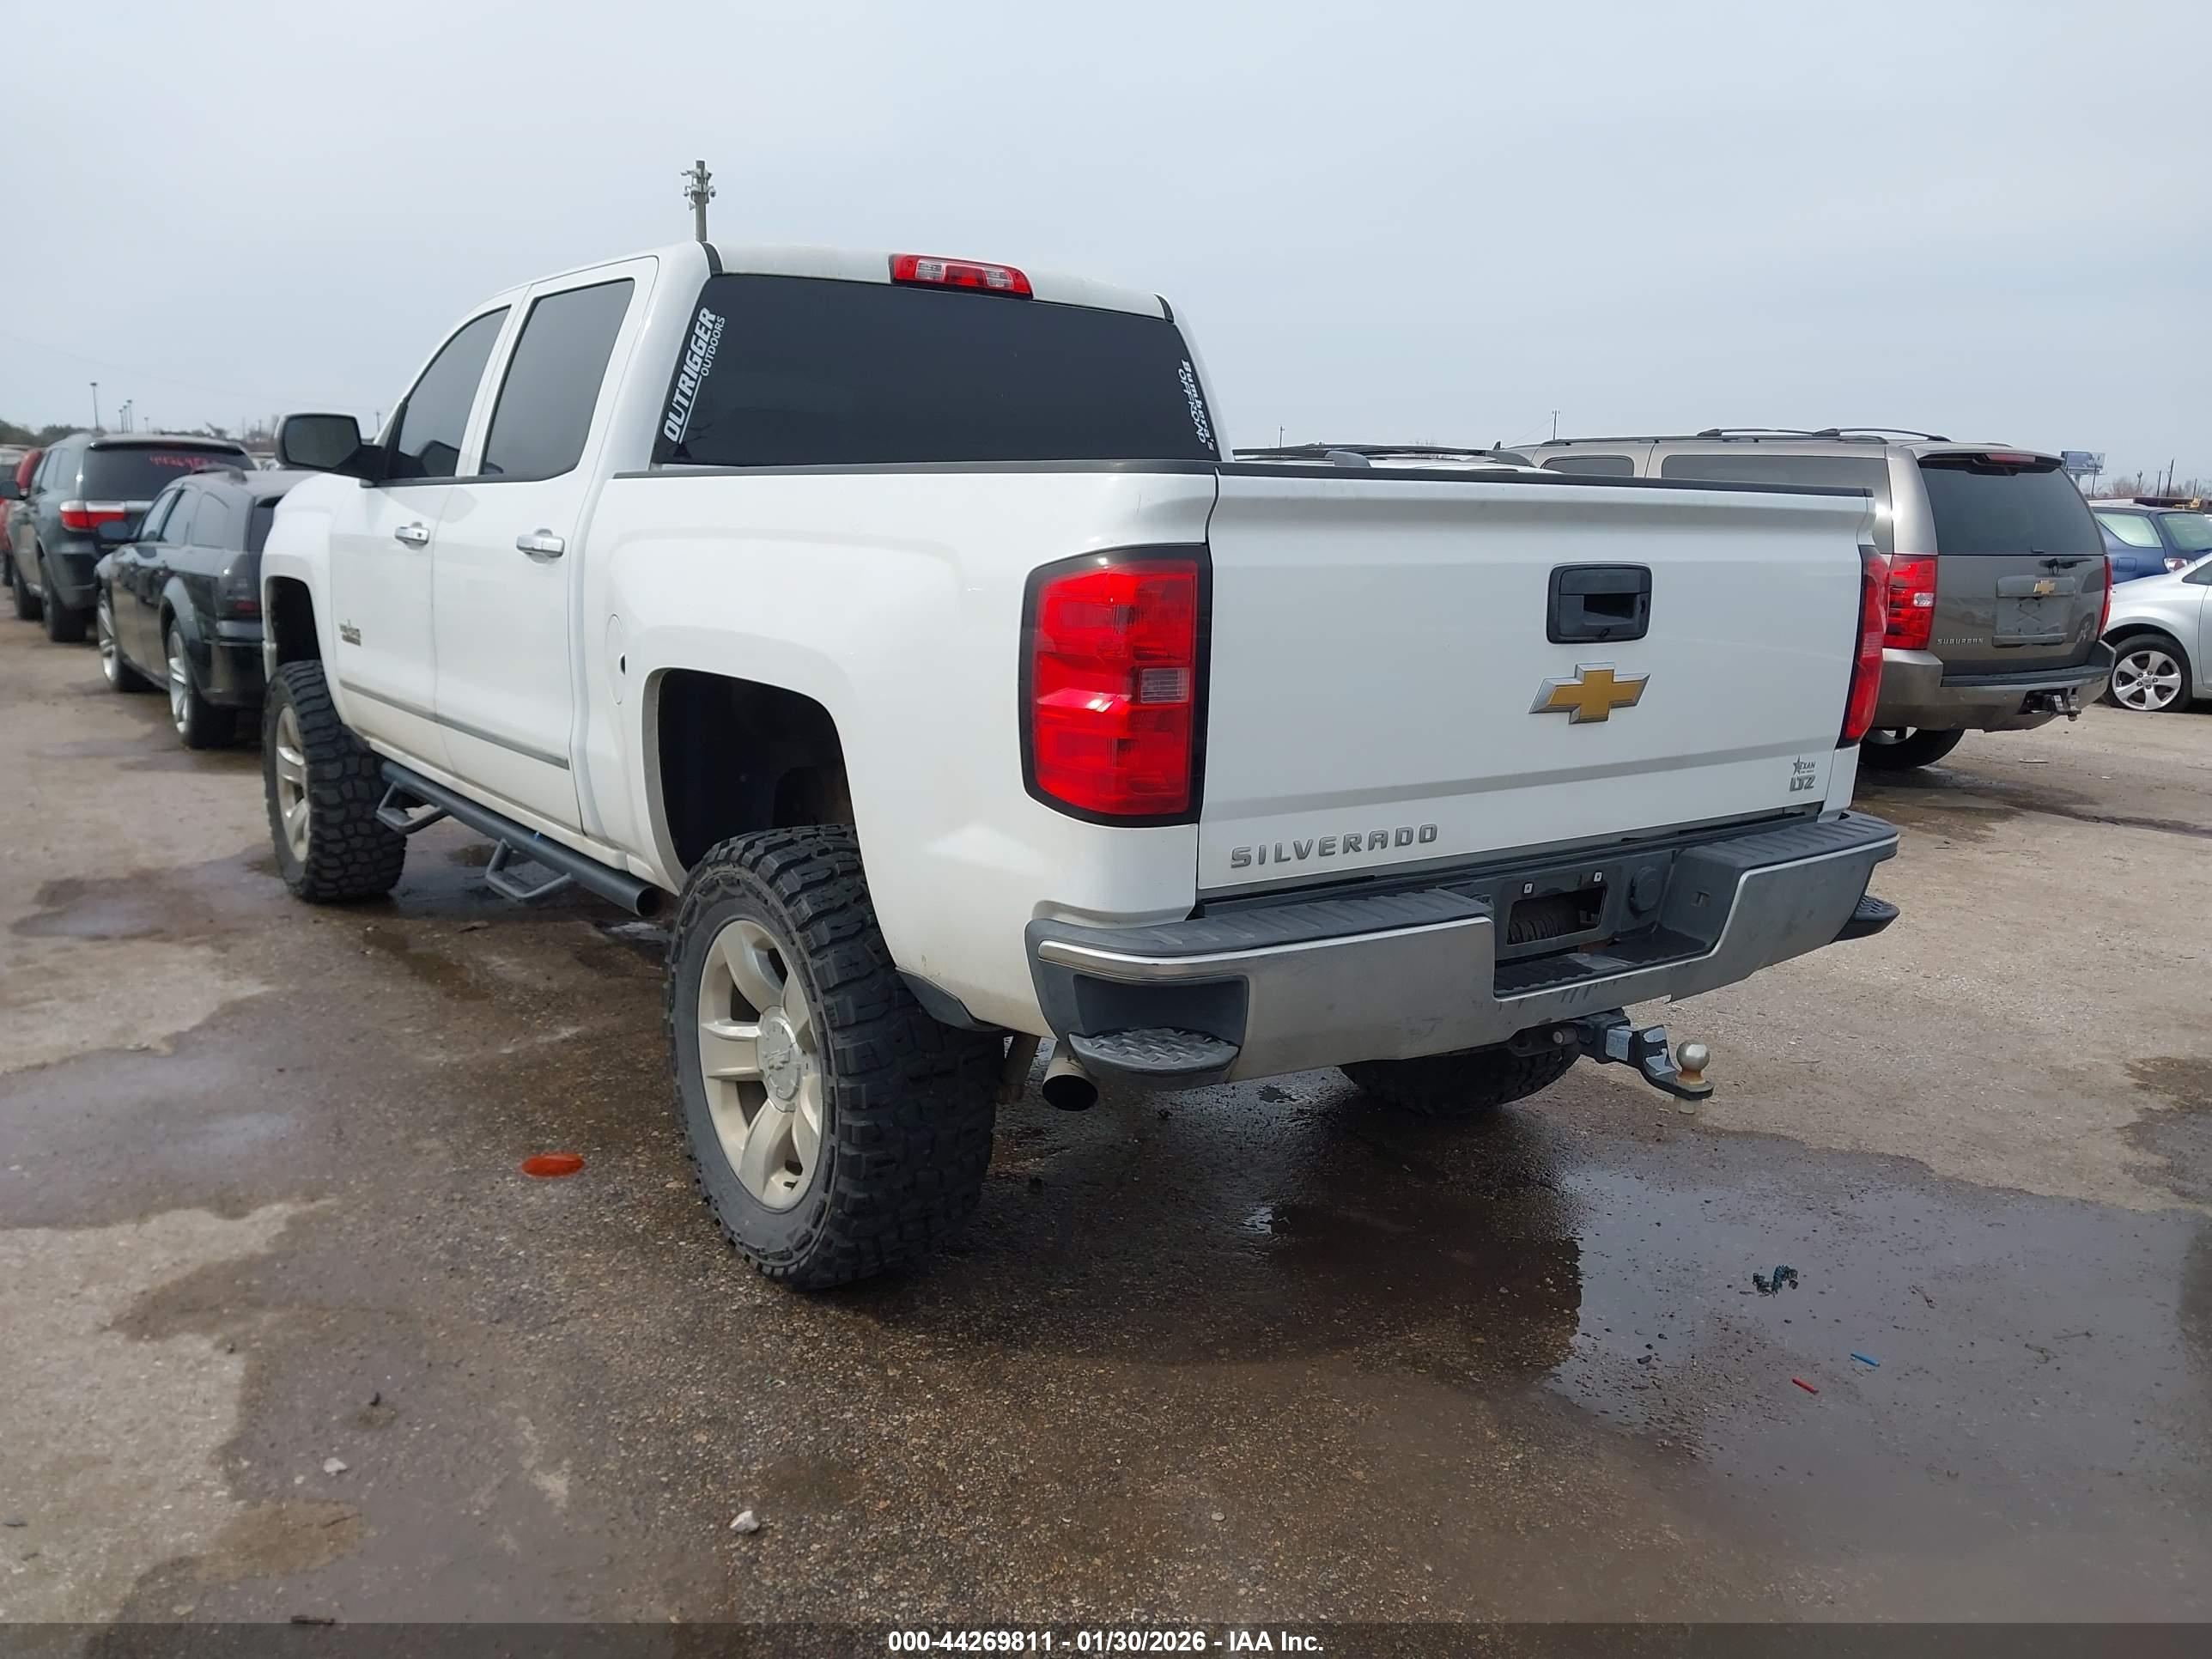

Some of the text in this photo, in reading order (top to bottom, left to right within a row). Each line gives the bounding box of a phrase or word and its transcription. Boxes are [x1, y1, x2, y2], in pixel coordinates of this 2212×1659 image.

[664, 307, 716, 442] OUTRIGGER
[700, 316, 726, 376] OUTDOORS
[1178, 368, 1206, 443] OFFROAD
[1231, 823, 1438, 869] SILVERADO
